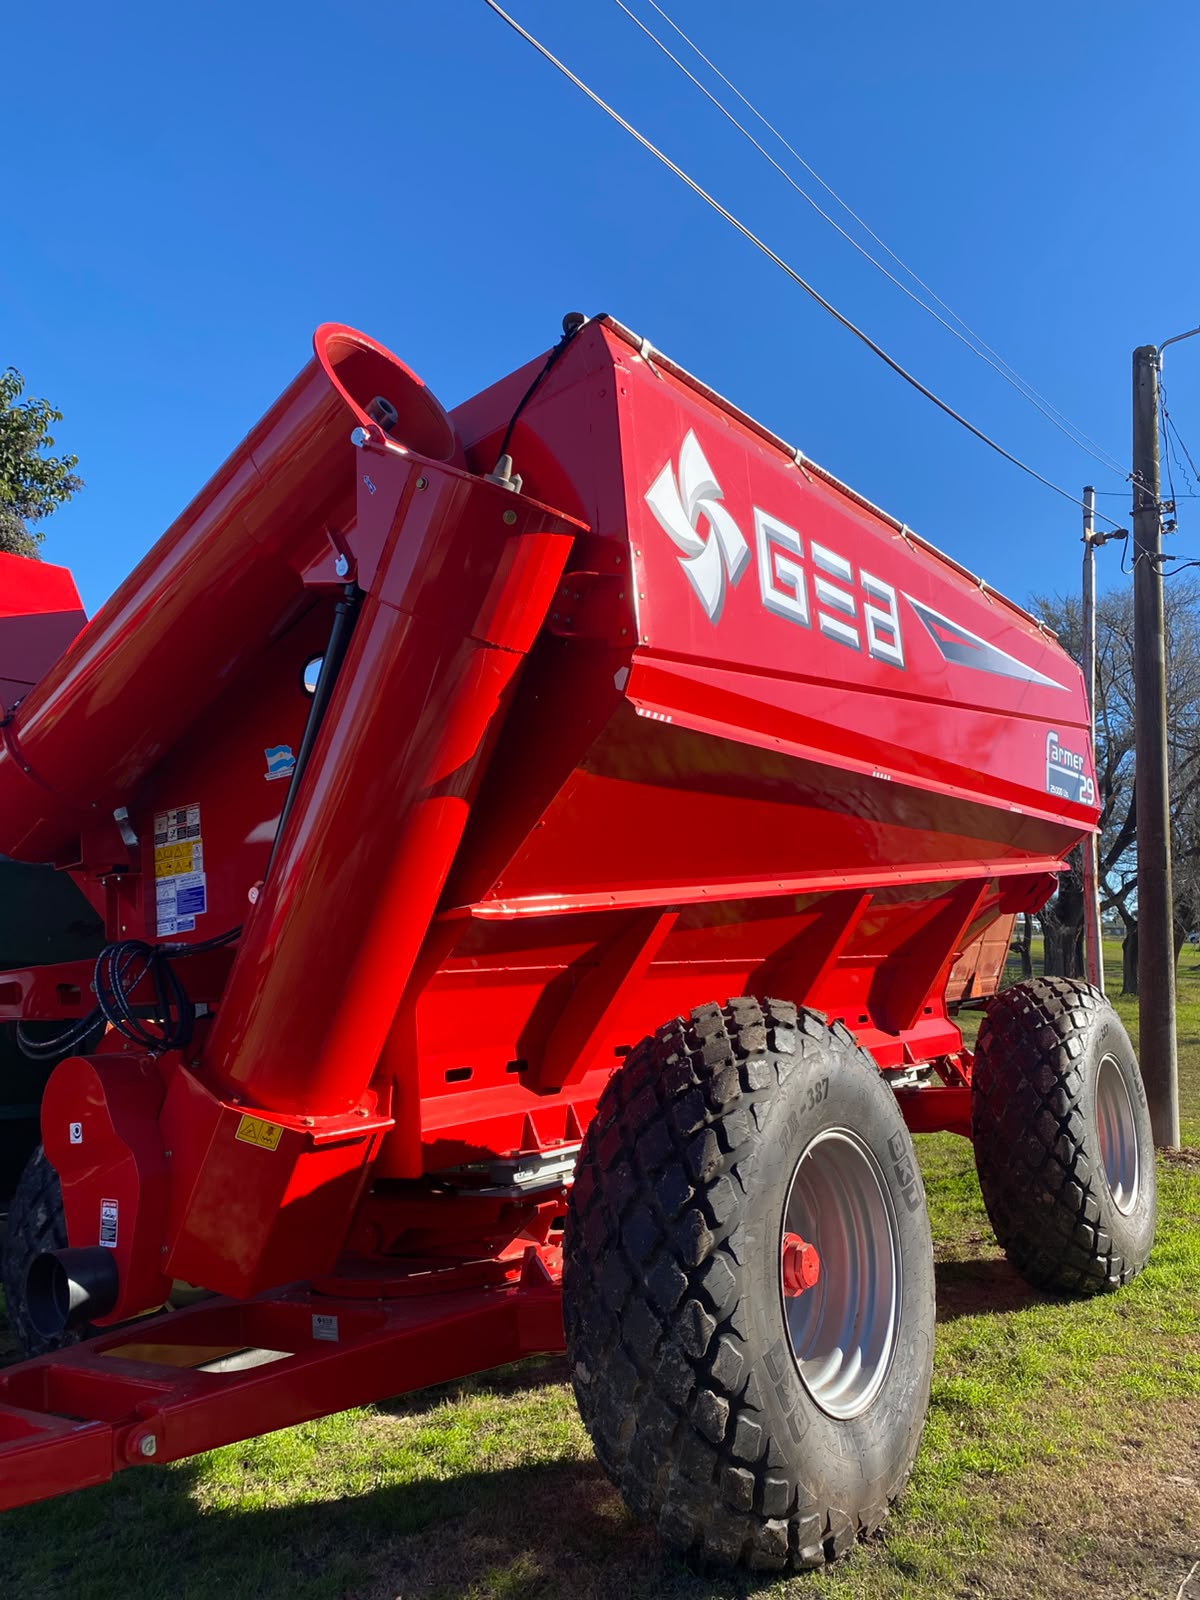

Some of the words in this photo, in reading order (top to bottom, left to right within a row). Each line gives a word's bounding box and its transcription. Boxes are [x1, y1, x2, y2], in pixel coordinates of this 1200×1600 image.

[753, 505, 905, 670] GEA
[1046, 730, 1084, 792] Farmer
[1079, 774, 1095, 805] 29
[887, 1129, 922, 1213] BKT
